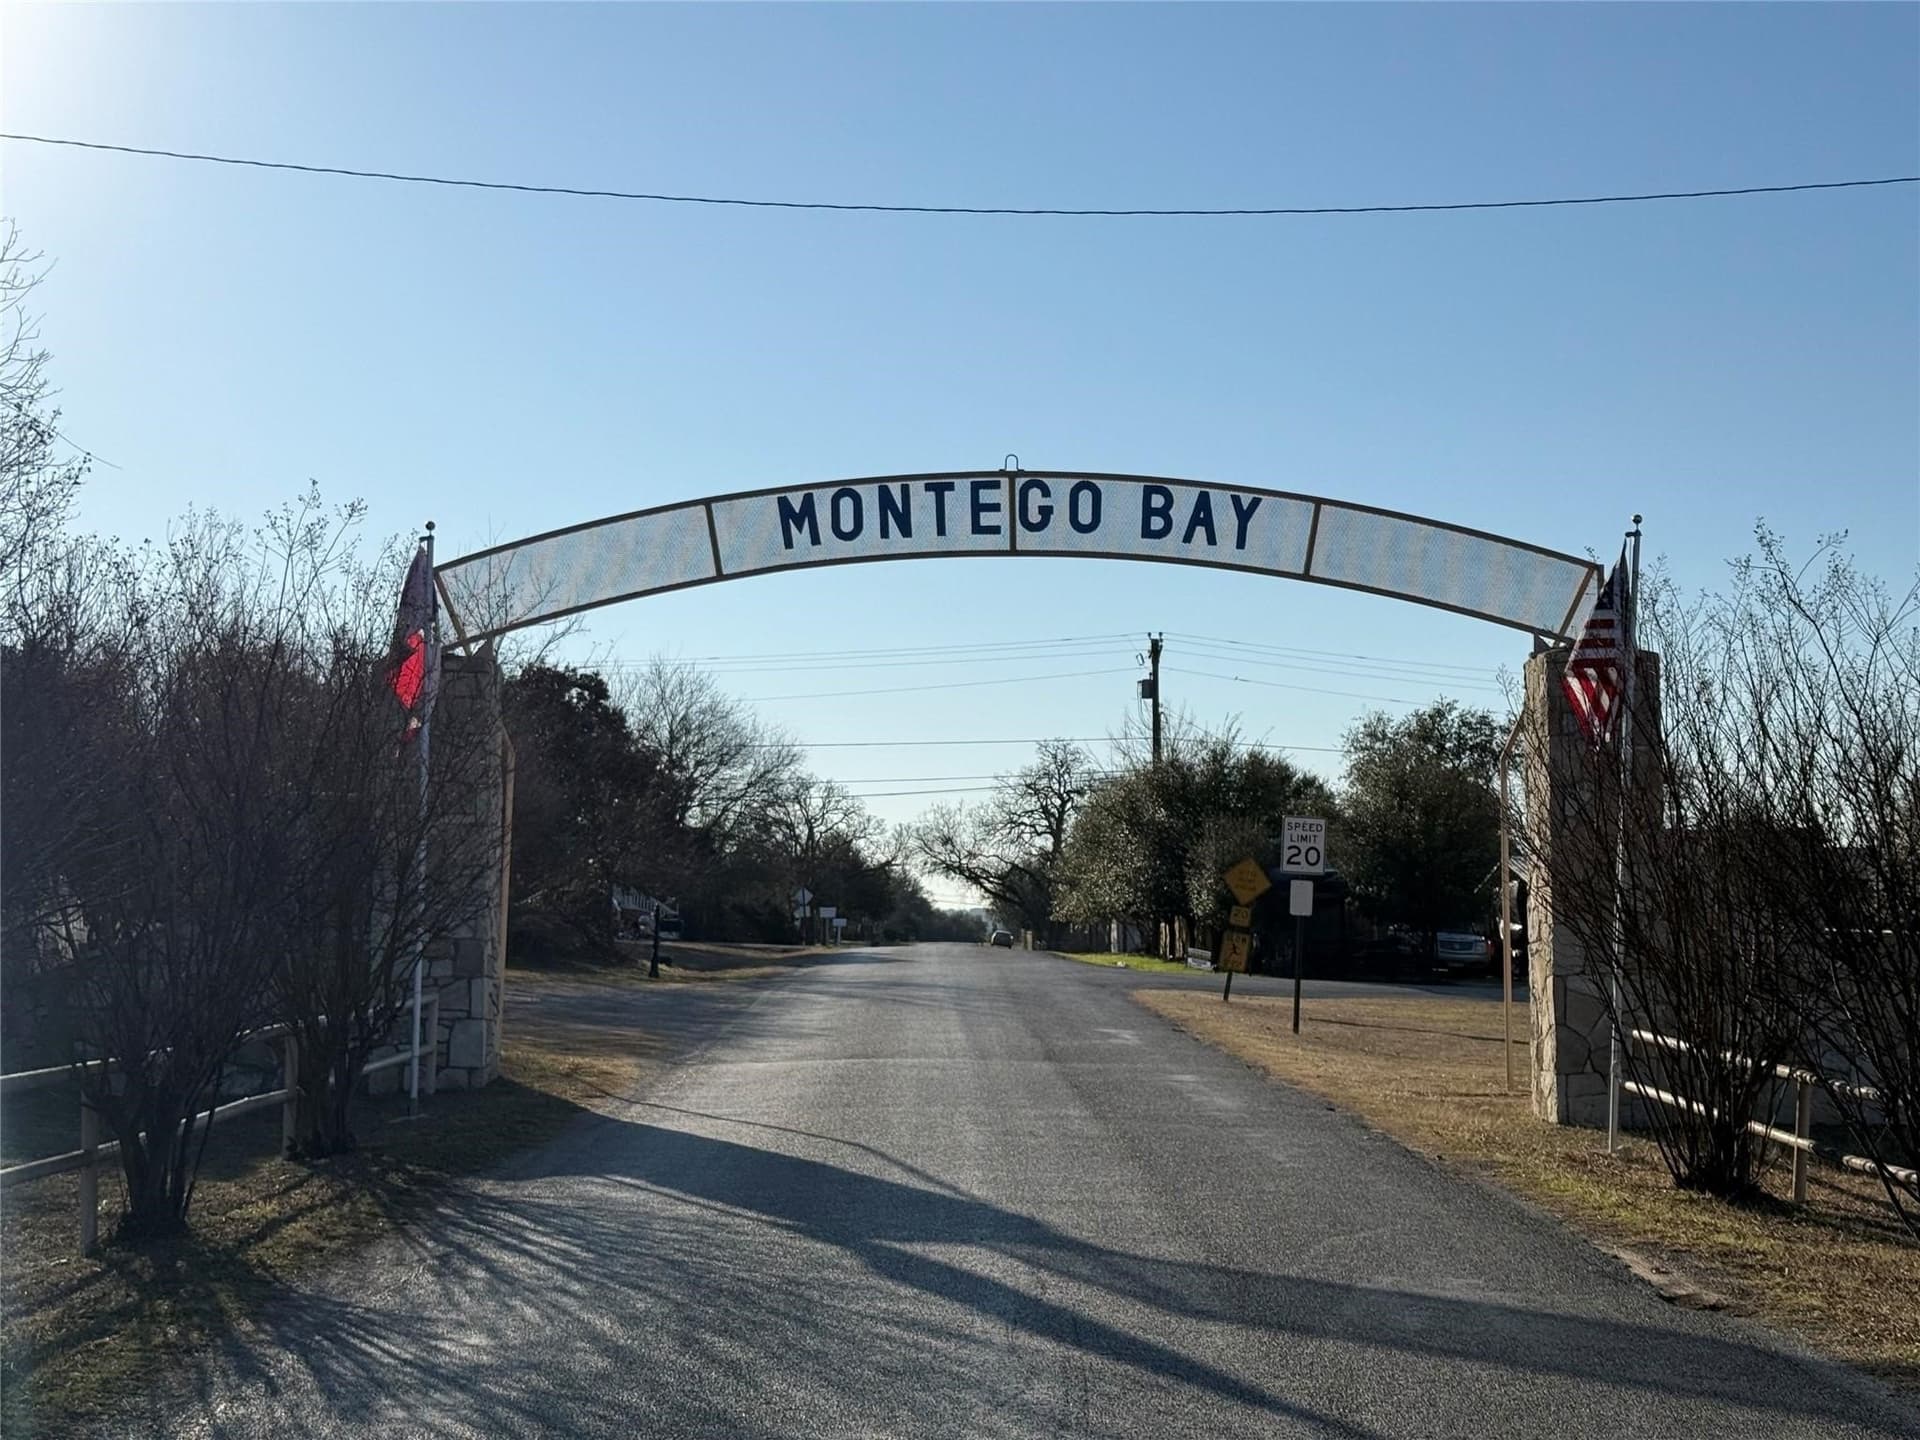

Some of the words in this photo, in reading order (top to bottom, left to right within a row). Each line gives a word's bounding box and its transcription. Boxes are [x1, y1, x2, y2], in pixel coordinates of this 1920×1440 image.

[777, 479, 1103, 550] MONTEGO
[1141, 484, 1263, 550] BAY
[1287, 822, 1323, 833] SPEED
[1289, 834, 1319, 844] LIMIT
[1286, 845, 1321, 866] 20
